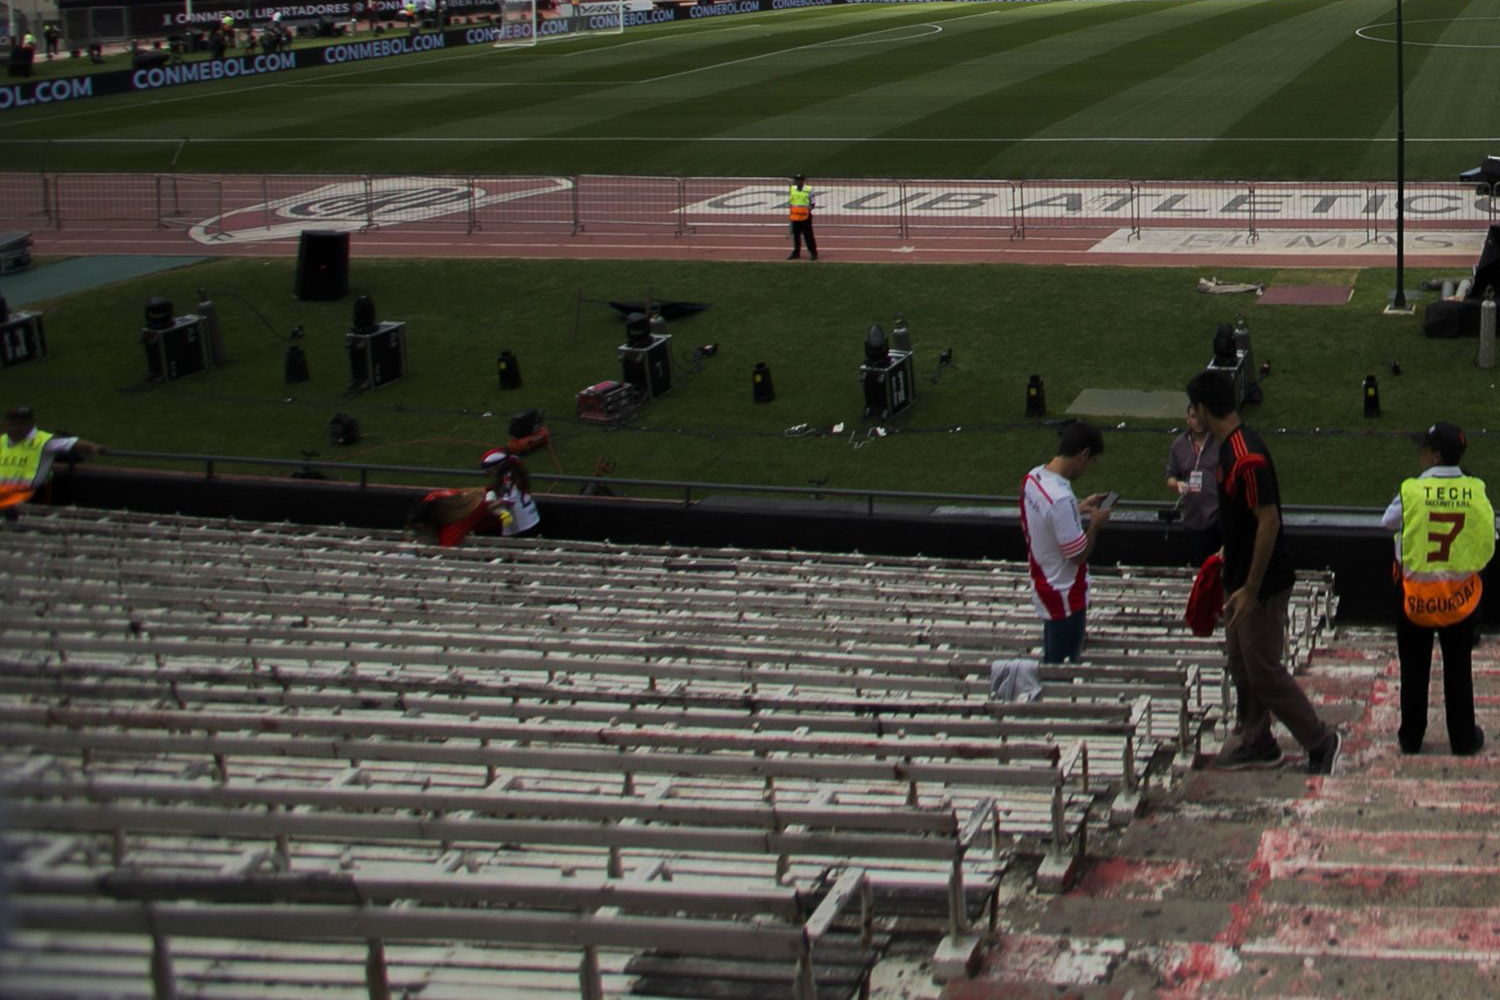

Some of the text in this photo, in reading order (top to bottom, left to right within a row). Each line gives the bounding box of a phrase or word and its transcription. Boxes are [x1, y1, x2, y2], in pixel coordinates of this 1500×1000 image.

[690, 0, 760, 19] CONMEBOL.COM
[324, 33, 445, 64] CONMEBOL.COM
[133, 50, 296, 90] CONMEBOL.COM
[1424, 487, 1472, 500] TECH
